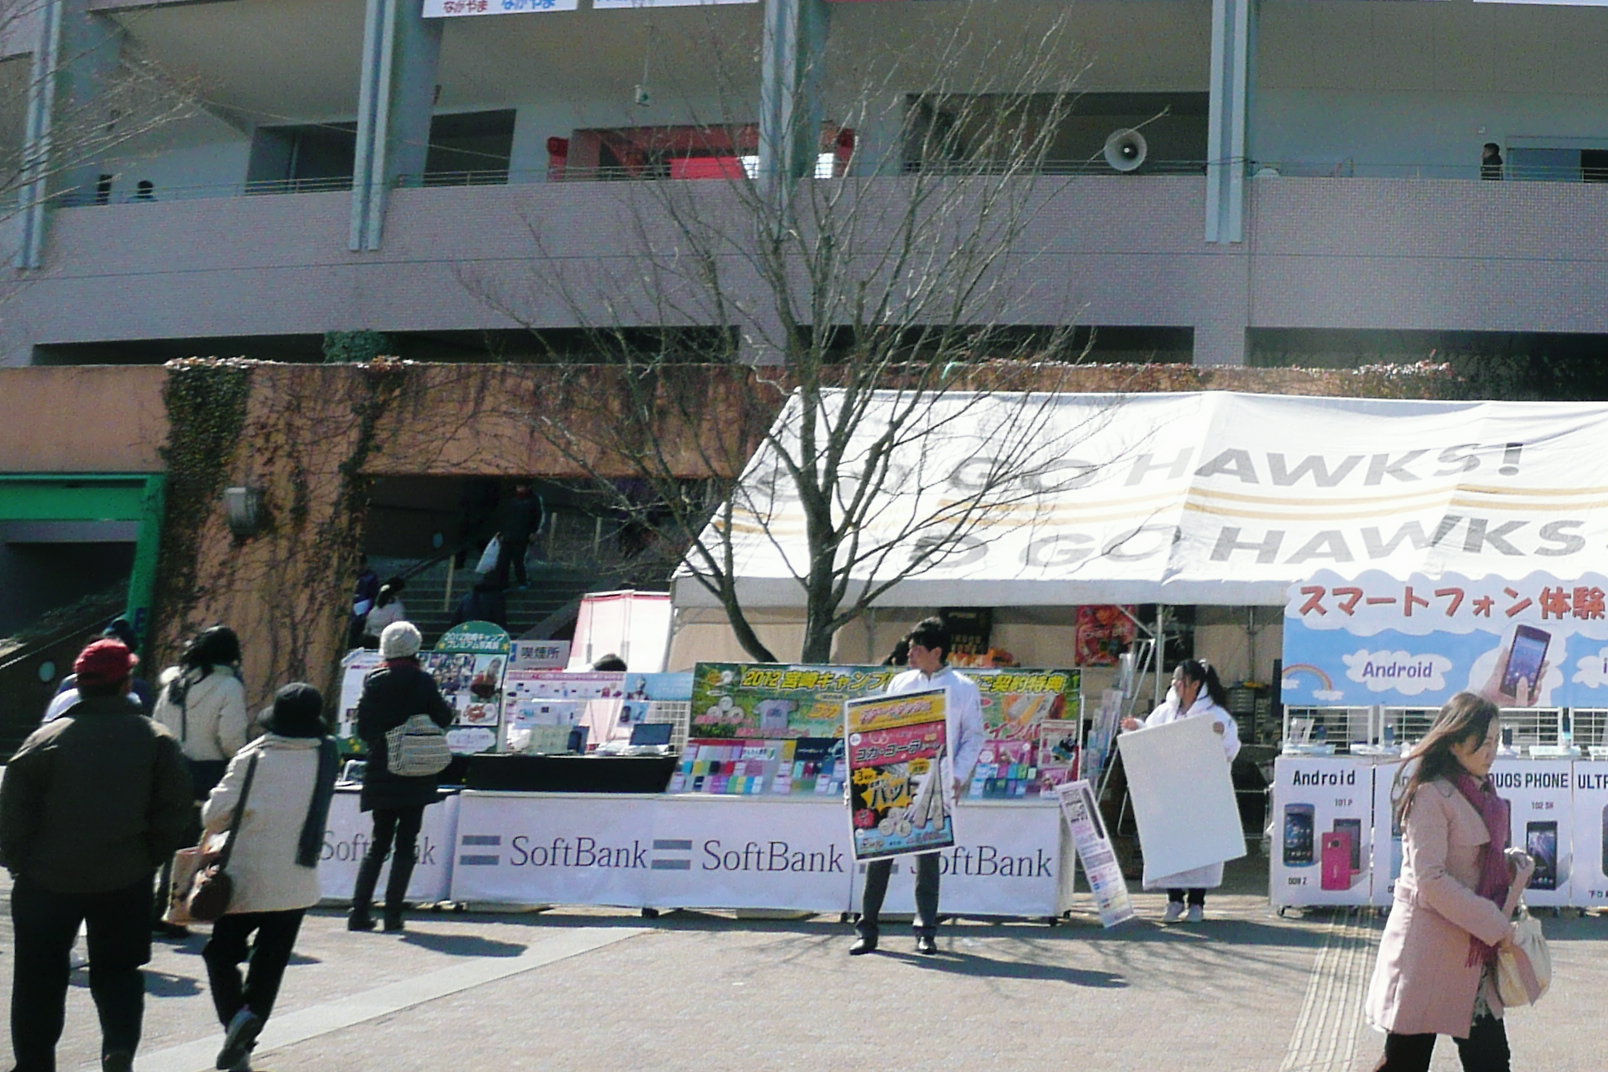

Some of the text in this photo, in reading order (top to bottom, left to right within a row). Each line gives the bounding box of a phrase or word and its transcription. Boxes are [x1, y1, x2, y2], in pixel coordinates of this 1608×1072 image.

[443, 0, 488, 14] ながやま
[1124, 441, 1524, 489] HAWKS!
[1361, 659, 1433, 679] Android
[1293, 769, 1356, 787] Android
[1524, 773, 1569, 789] PHONE
[510, 835, 648, 869] SoftBank
[701, 838, 845, 874] SoftBank
[910, 844, 1053, 878] oftBank
